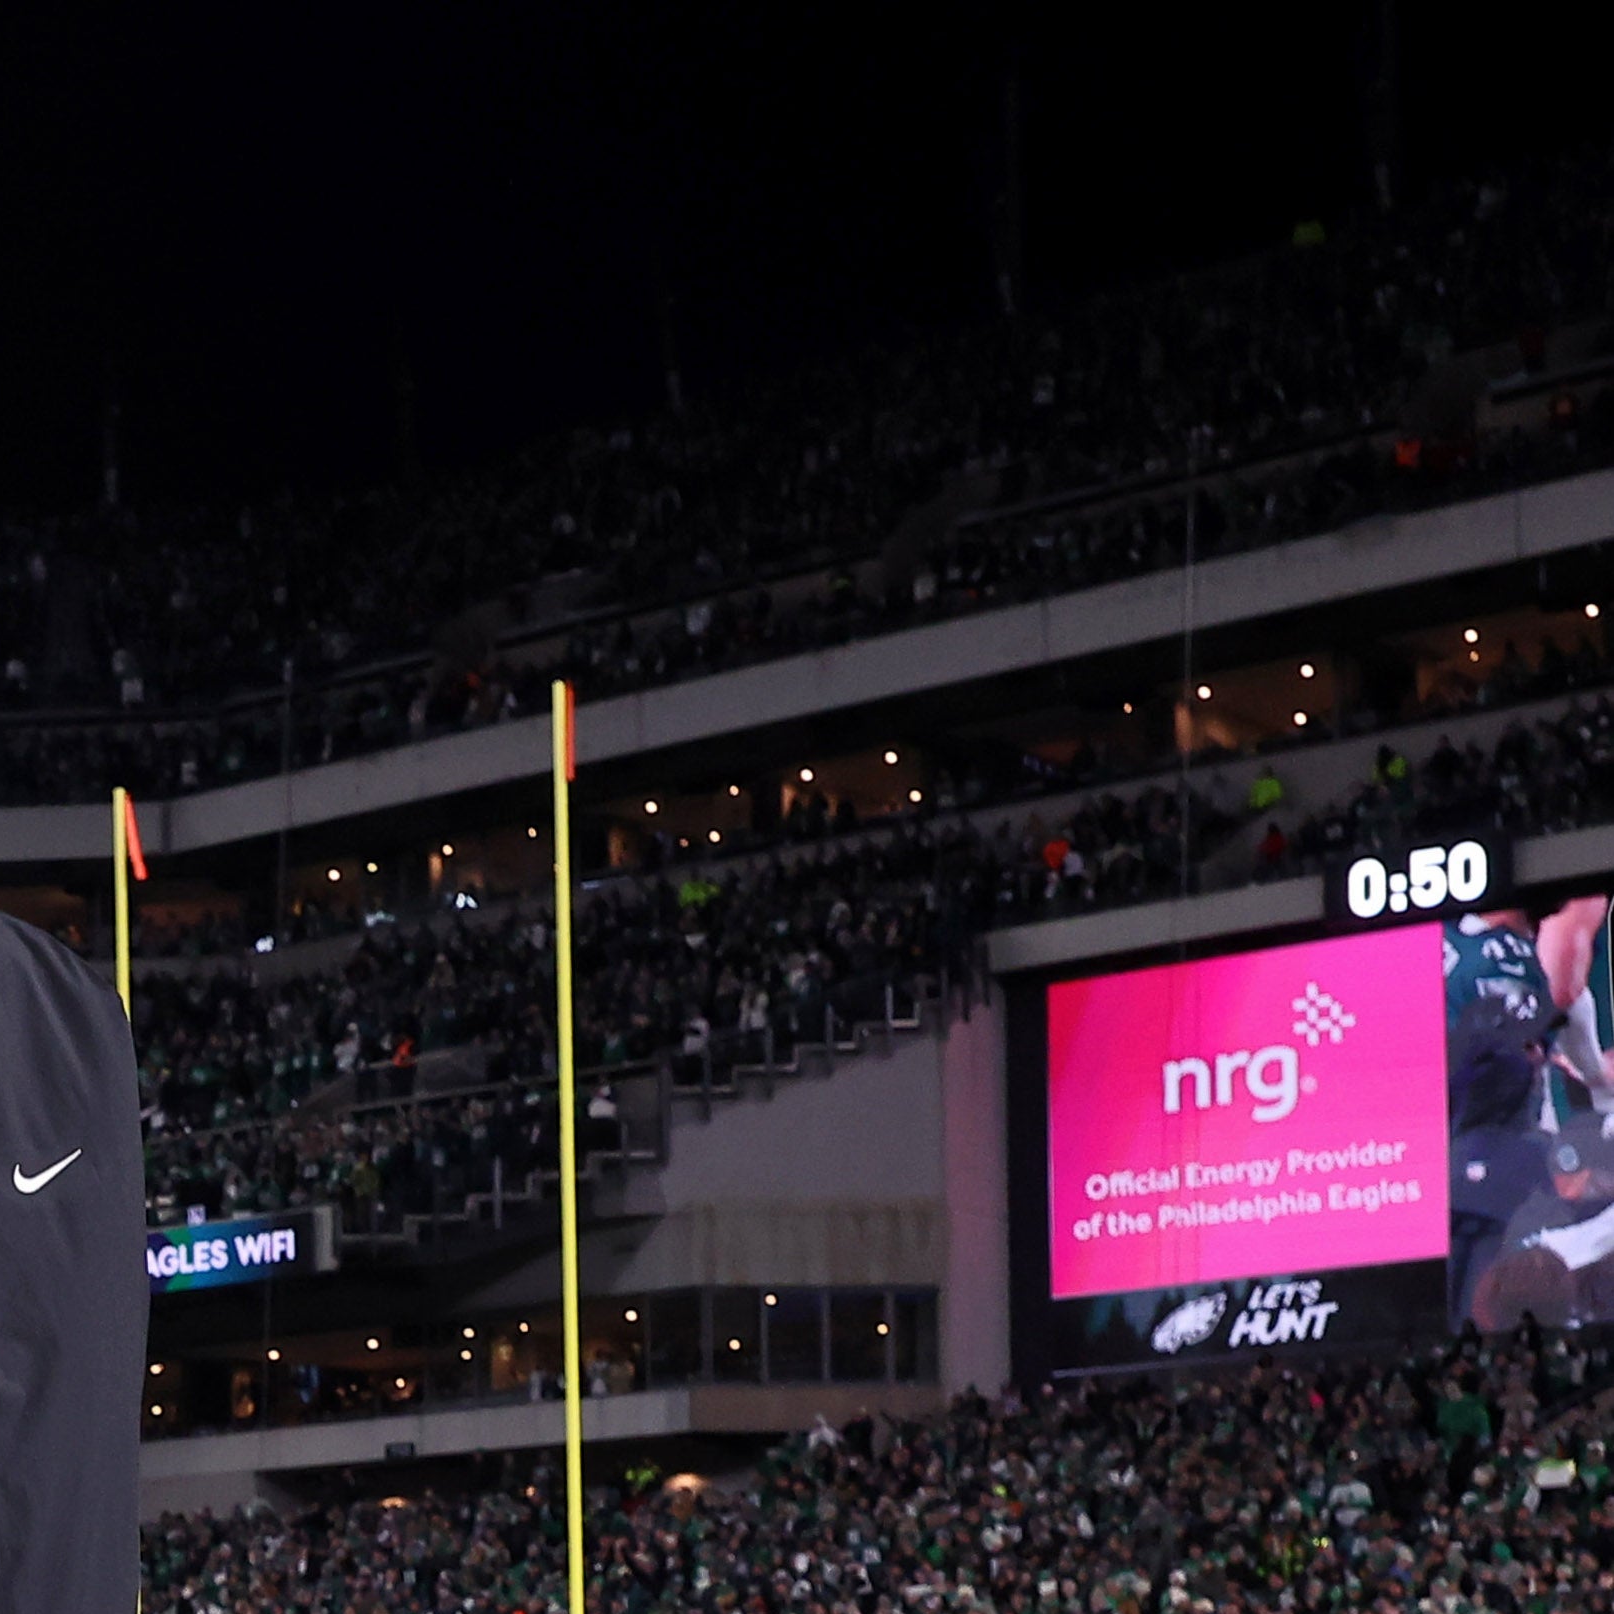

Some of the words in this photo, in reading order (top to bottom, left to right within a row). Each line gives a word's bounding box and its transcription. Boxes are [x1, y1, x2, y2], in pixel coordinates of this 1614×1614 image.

[1348, 840, 1488, 918] 0:50
[1162, 1043, 1299, 1122] nrg
[1085, 1164, 1180, 1201] Official
[1185, 1157, 1281, 1189] Energy
[1287, 1138, 1407, 1176] Provider
[1073, 1211, 1104, 1241] of
[1106, 1210, 1153, 1238] the
[1158, 1188, 1322, 1231] Philadelphia
[1327, 1178, 1421, 1213] Eagles
[234, 1228, 296, 1266] WIFI
[1228, 1301, 1339, 1347] HUNT
